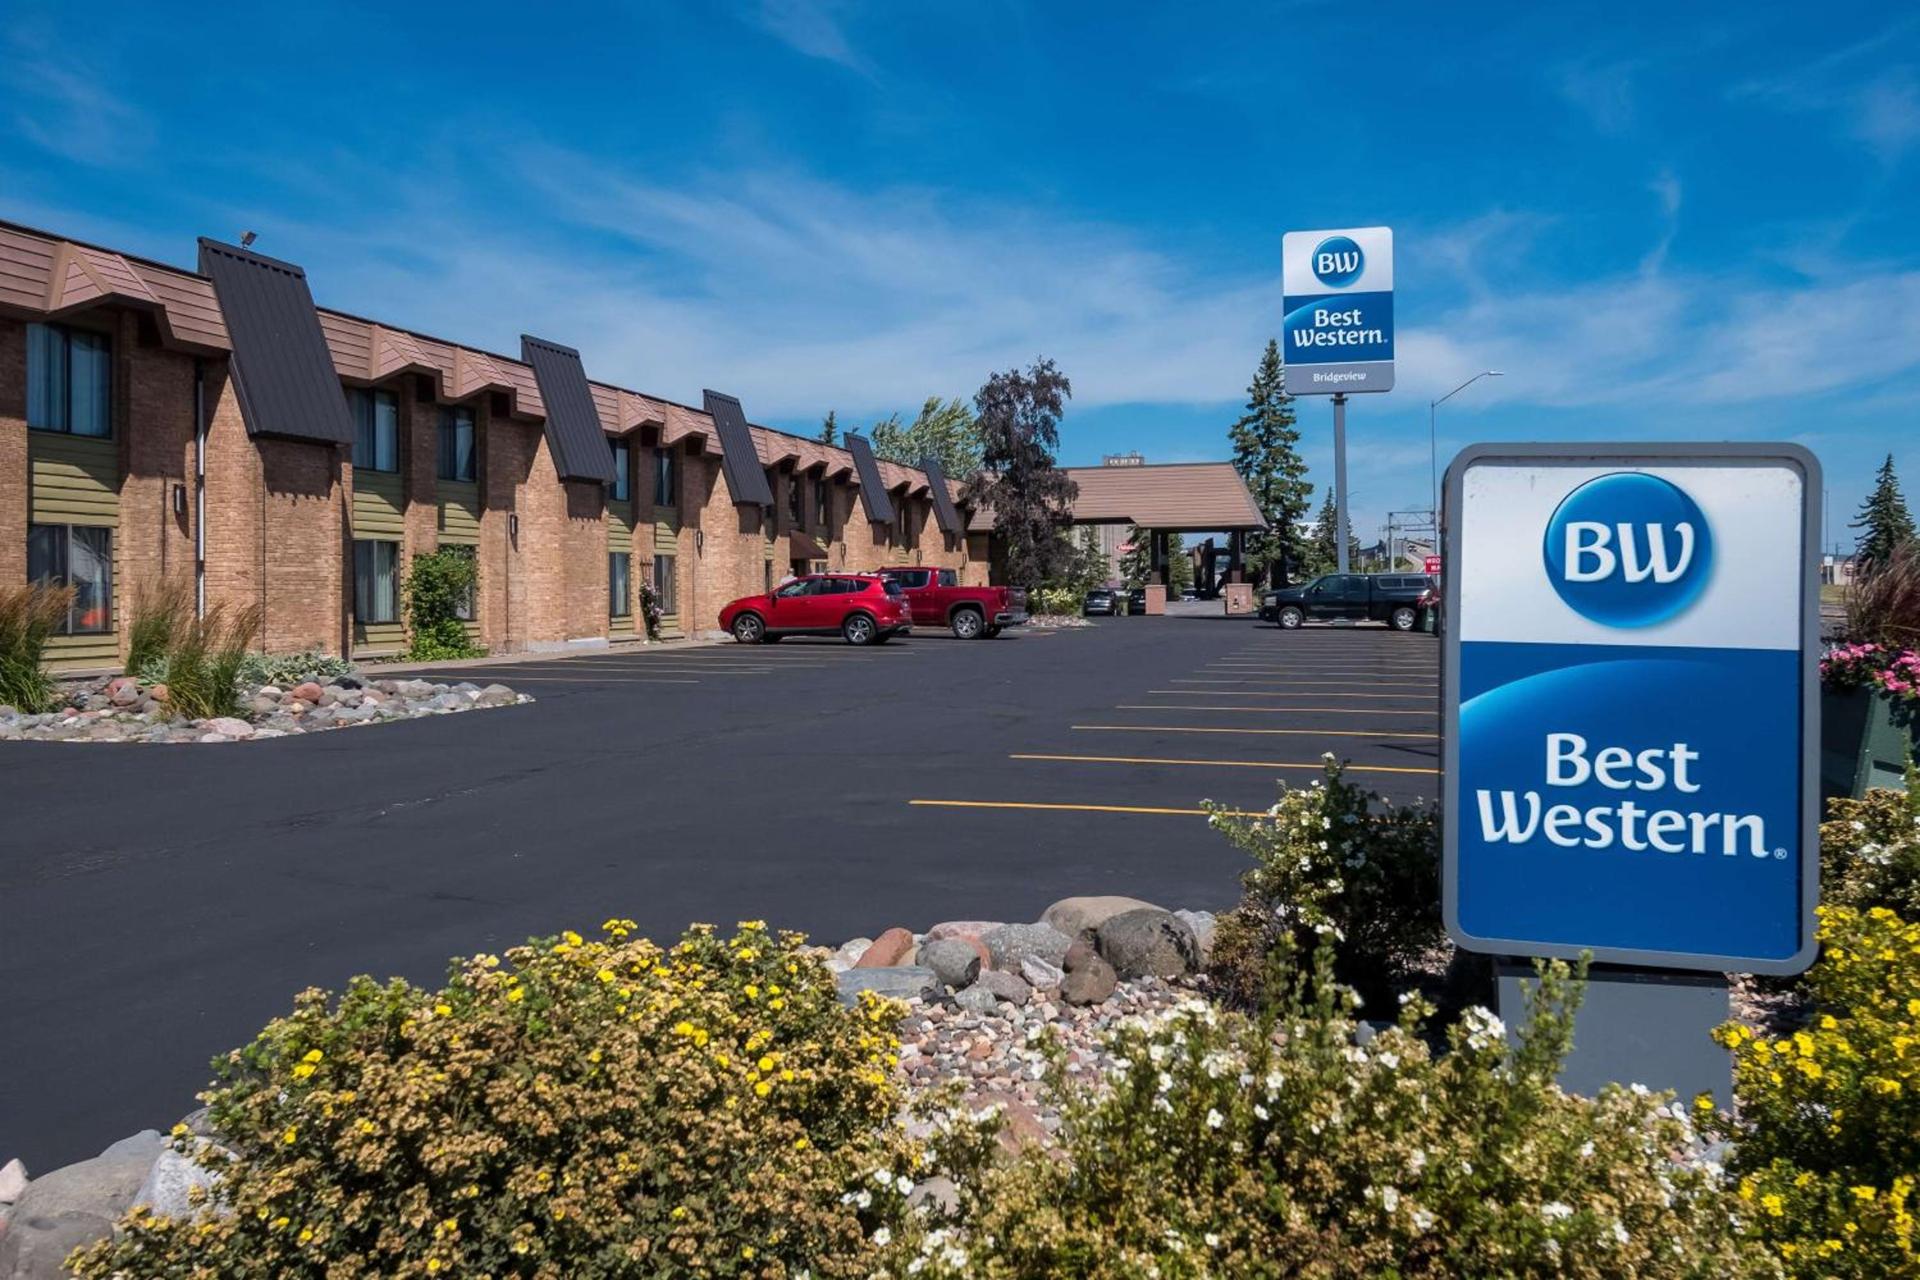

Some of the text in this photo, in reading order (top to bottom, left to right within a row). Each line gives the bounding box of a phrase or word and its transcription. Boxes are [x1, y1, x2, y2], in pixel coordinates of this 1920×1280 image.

[1318, 252, 1359, 274] BW
[1315, 309, 1362, 327] Best
[1294, 328, 1382, 347] Western
[1313, 371, 1367, 383] Bridgeview
[1564, 521, 1694, 583] BW
[1546, 733, 1700, 792] Best
[1477, 789, 1768, 858] Western
